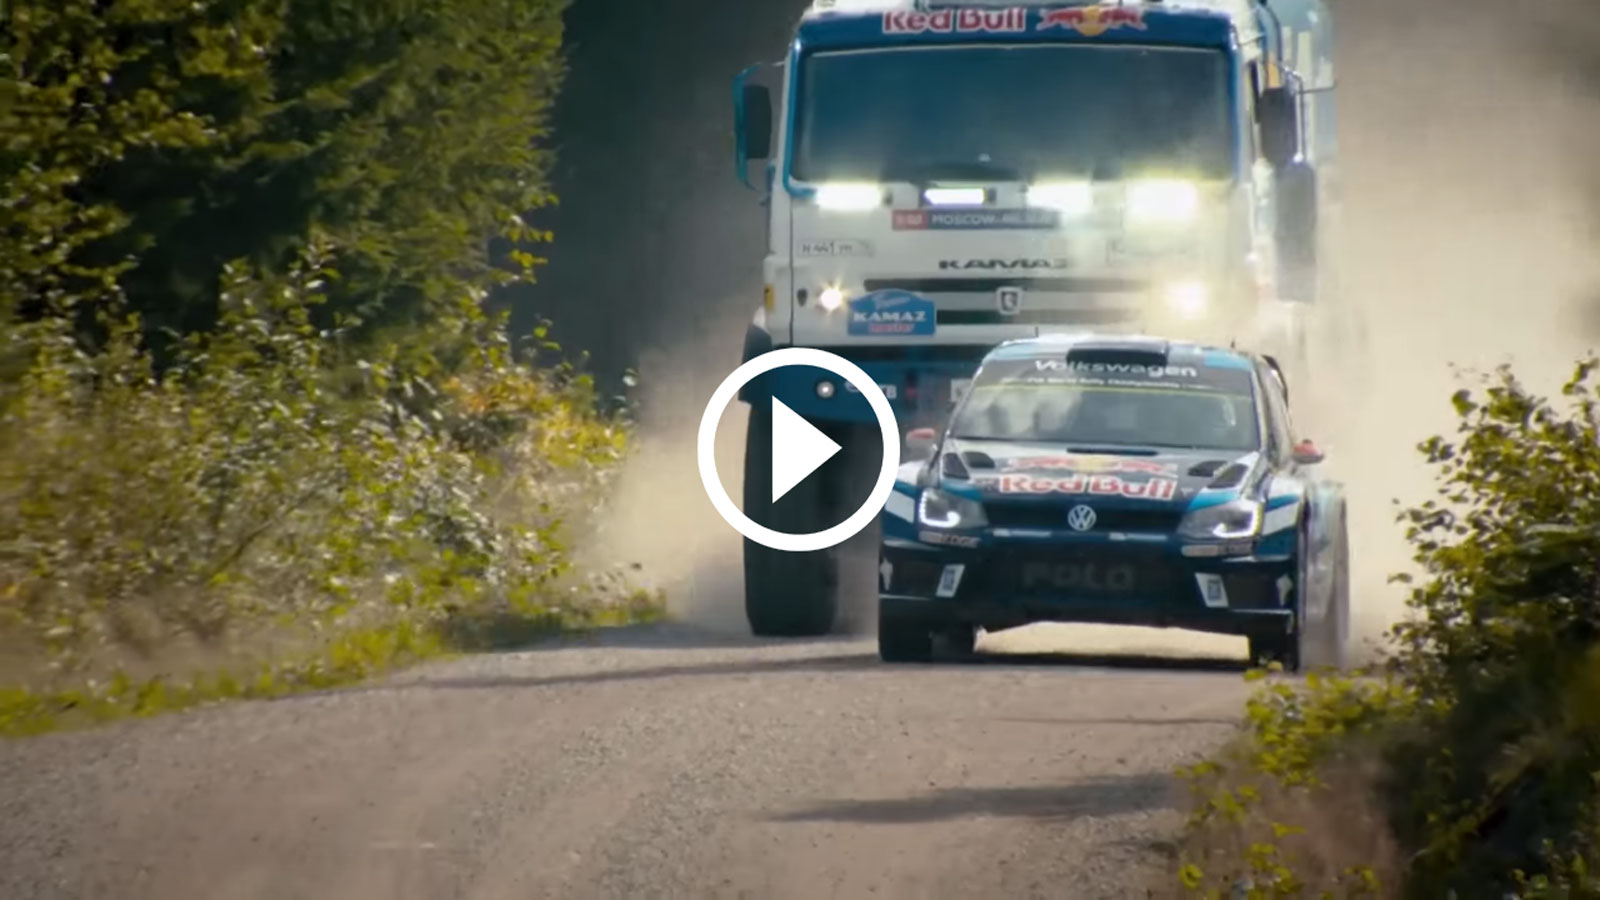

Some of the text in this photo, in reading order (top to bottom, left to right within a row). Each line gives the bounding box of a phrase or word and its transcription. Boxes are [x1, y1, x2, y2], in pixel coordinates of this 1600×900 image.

[882, 7, 1027, 33] Red Bull
[853, 311, 926, 322] KAMAZ
[1034, 360, 1198, 377] Volkswagen
[999, 473, 1178, 500] Red Bull
[1023, 561, 1135, 591] POLO
